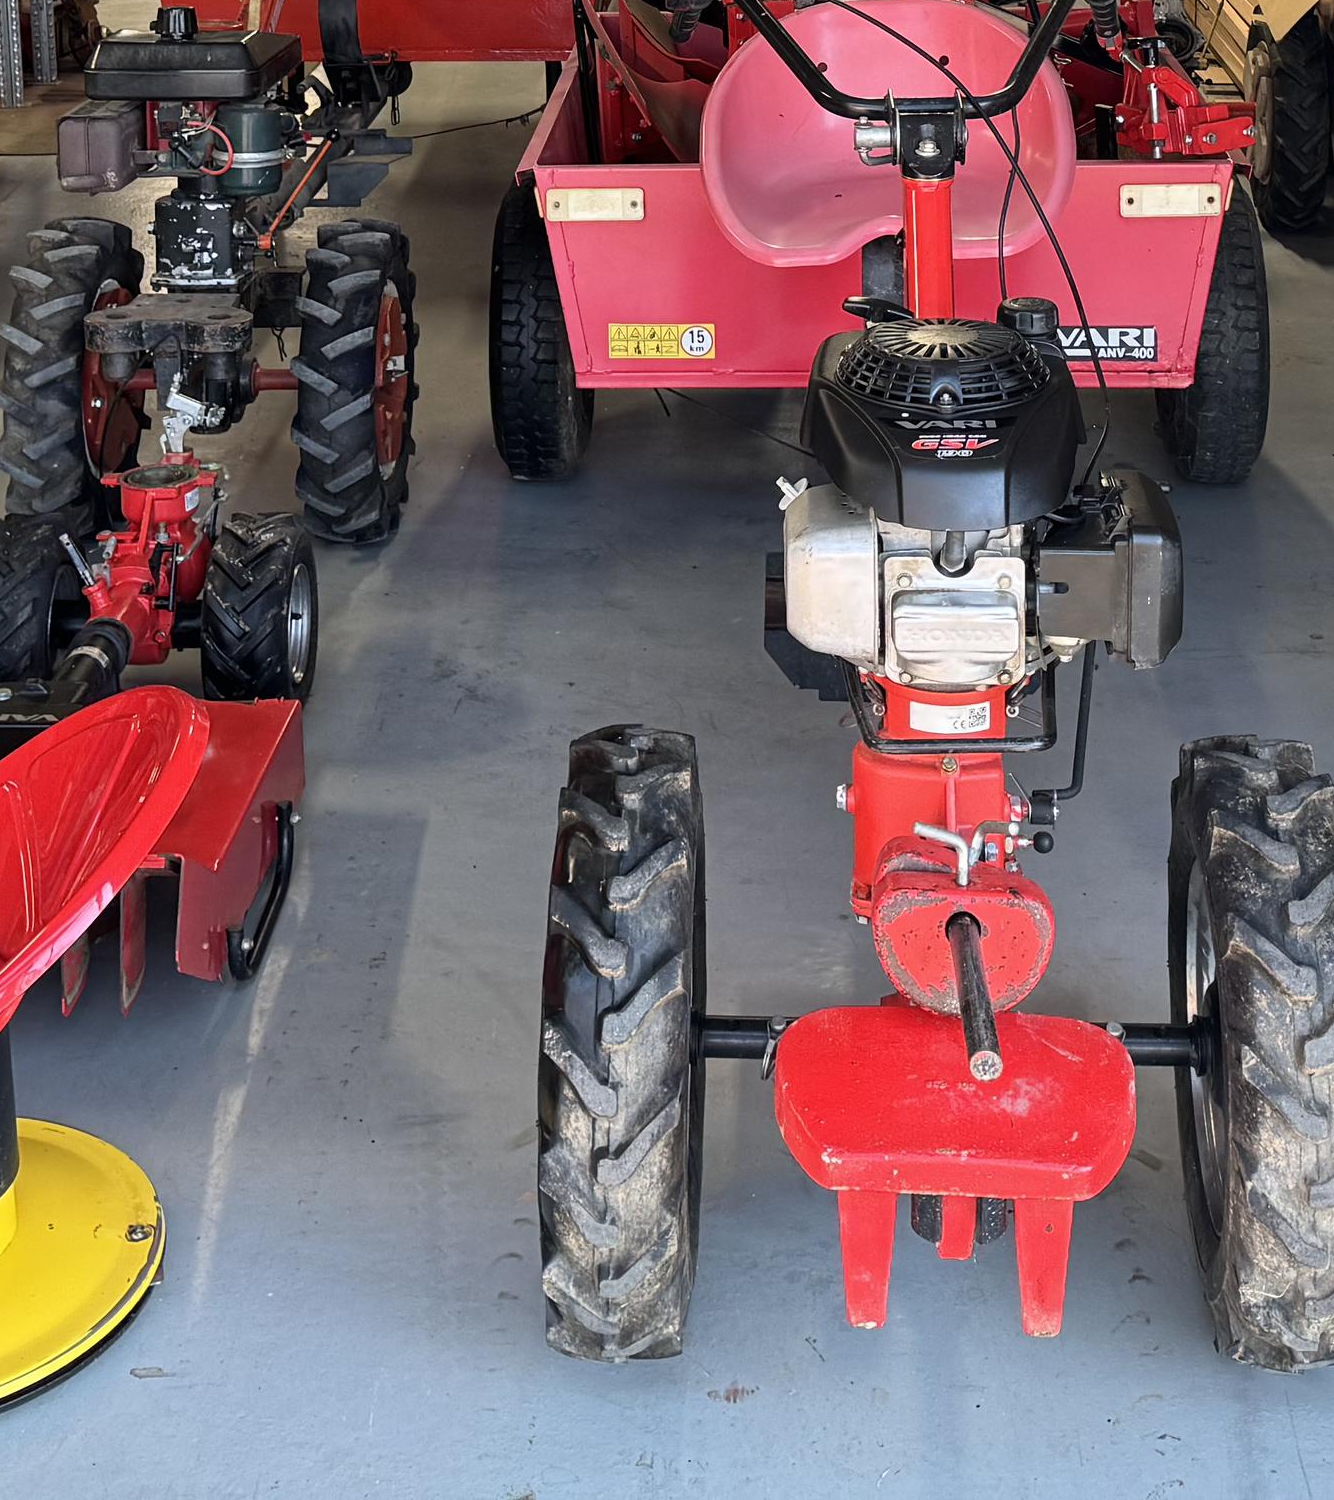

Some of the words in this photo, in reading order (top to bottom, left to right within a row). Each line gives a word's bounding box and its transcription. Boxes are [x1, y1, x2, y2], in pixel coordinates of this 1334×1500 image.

[689, 329, 705, 344] 15
[1056, 328, 1156, 347] VARI
[1095, 348, 1155, 359] ANV-400
[894, 419, 998, 430] VARI
[905, 627, 1011, 642] HONDA
